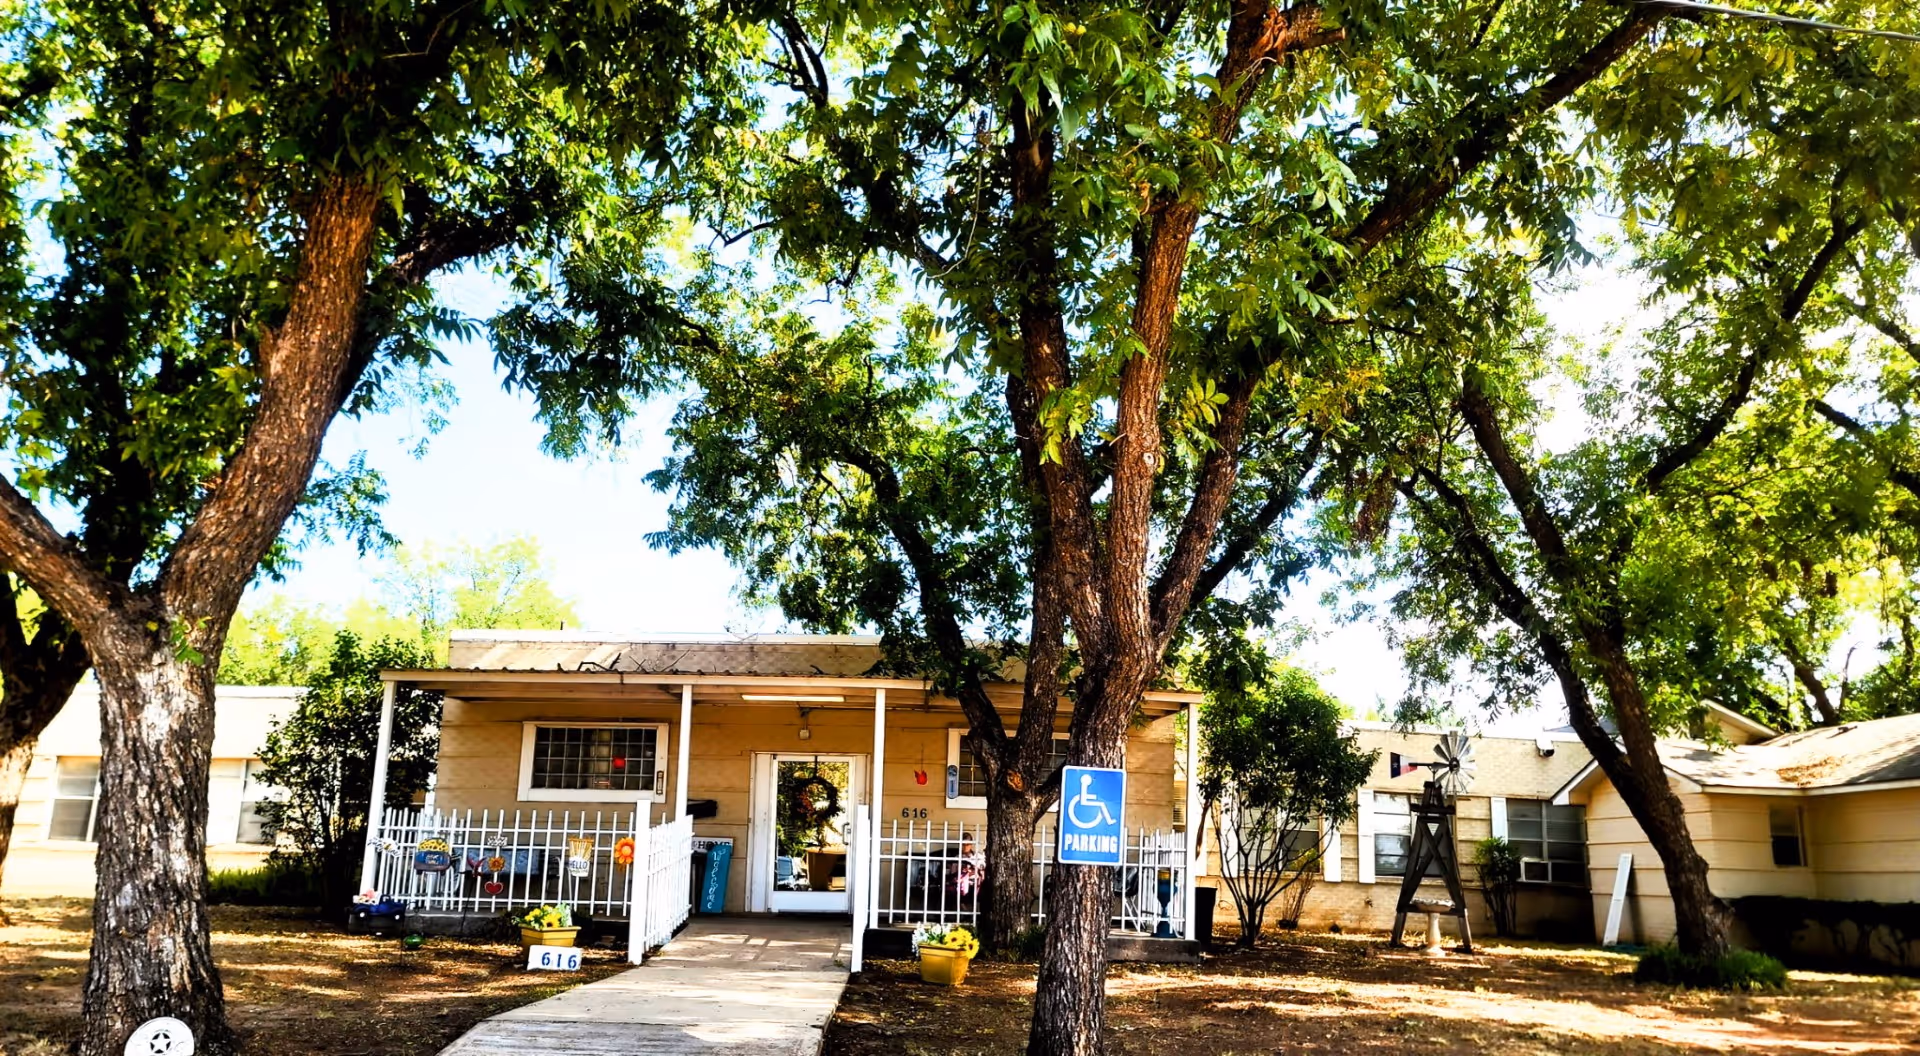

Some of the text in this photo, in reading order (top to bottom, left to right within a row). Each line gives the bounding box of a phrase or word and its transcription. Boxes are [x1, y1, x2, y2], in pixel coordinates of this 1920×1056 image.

[902, 807, 928, 819] 616
[1064, 833, 1119, 853] PARKING
[541, 951, 577, 969] 616
